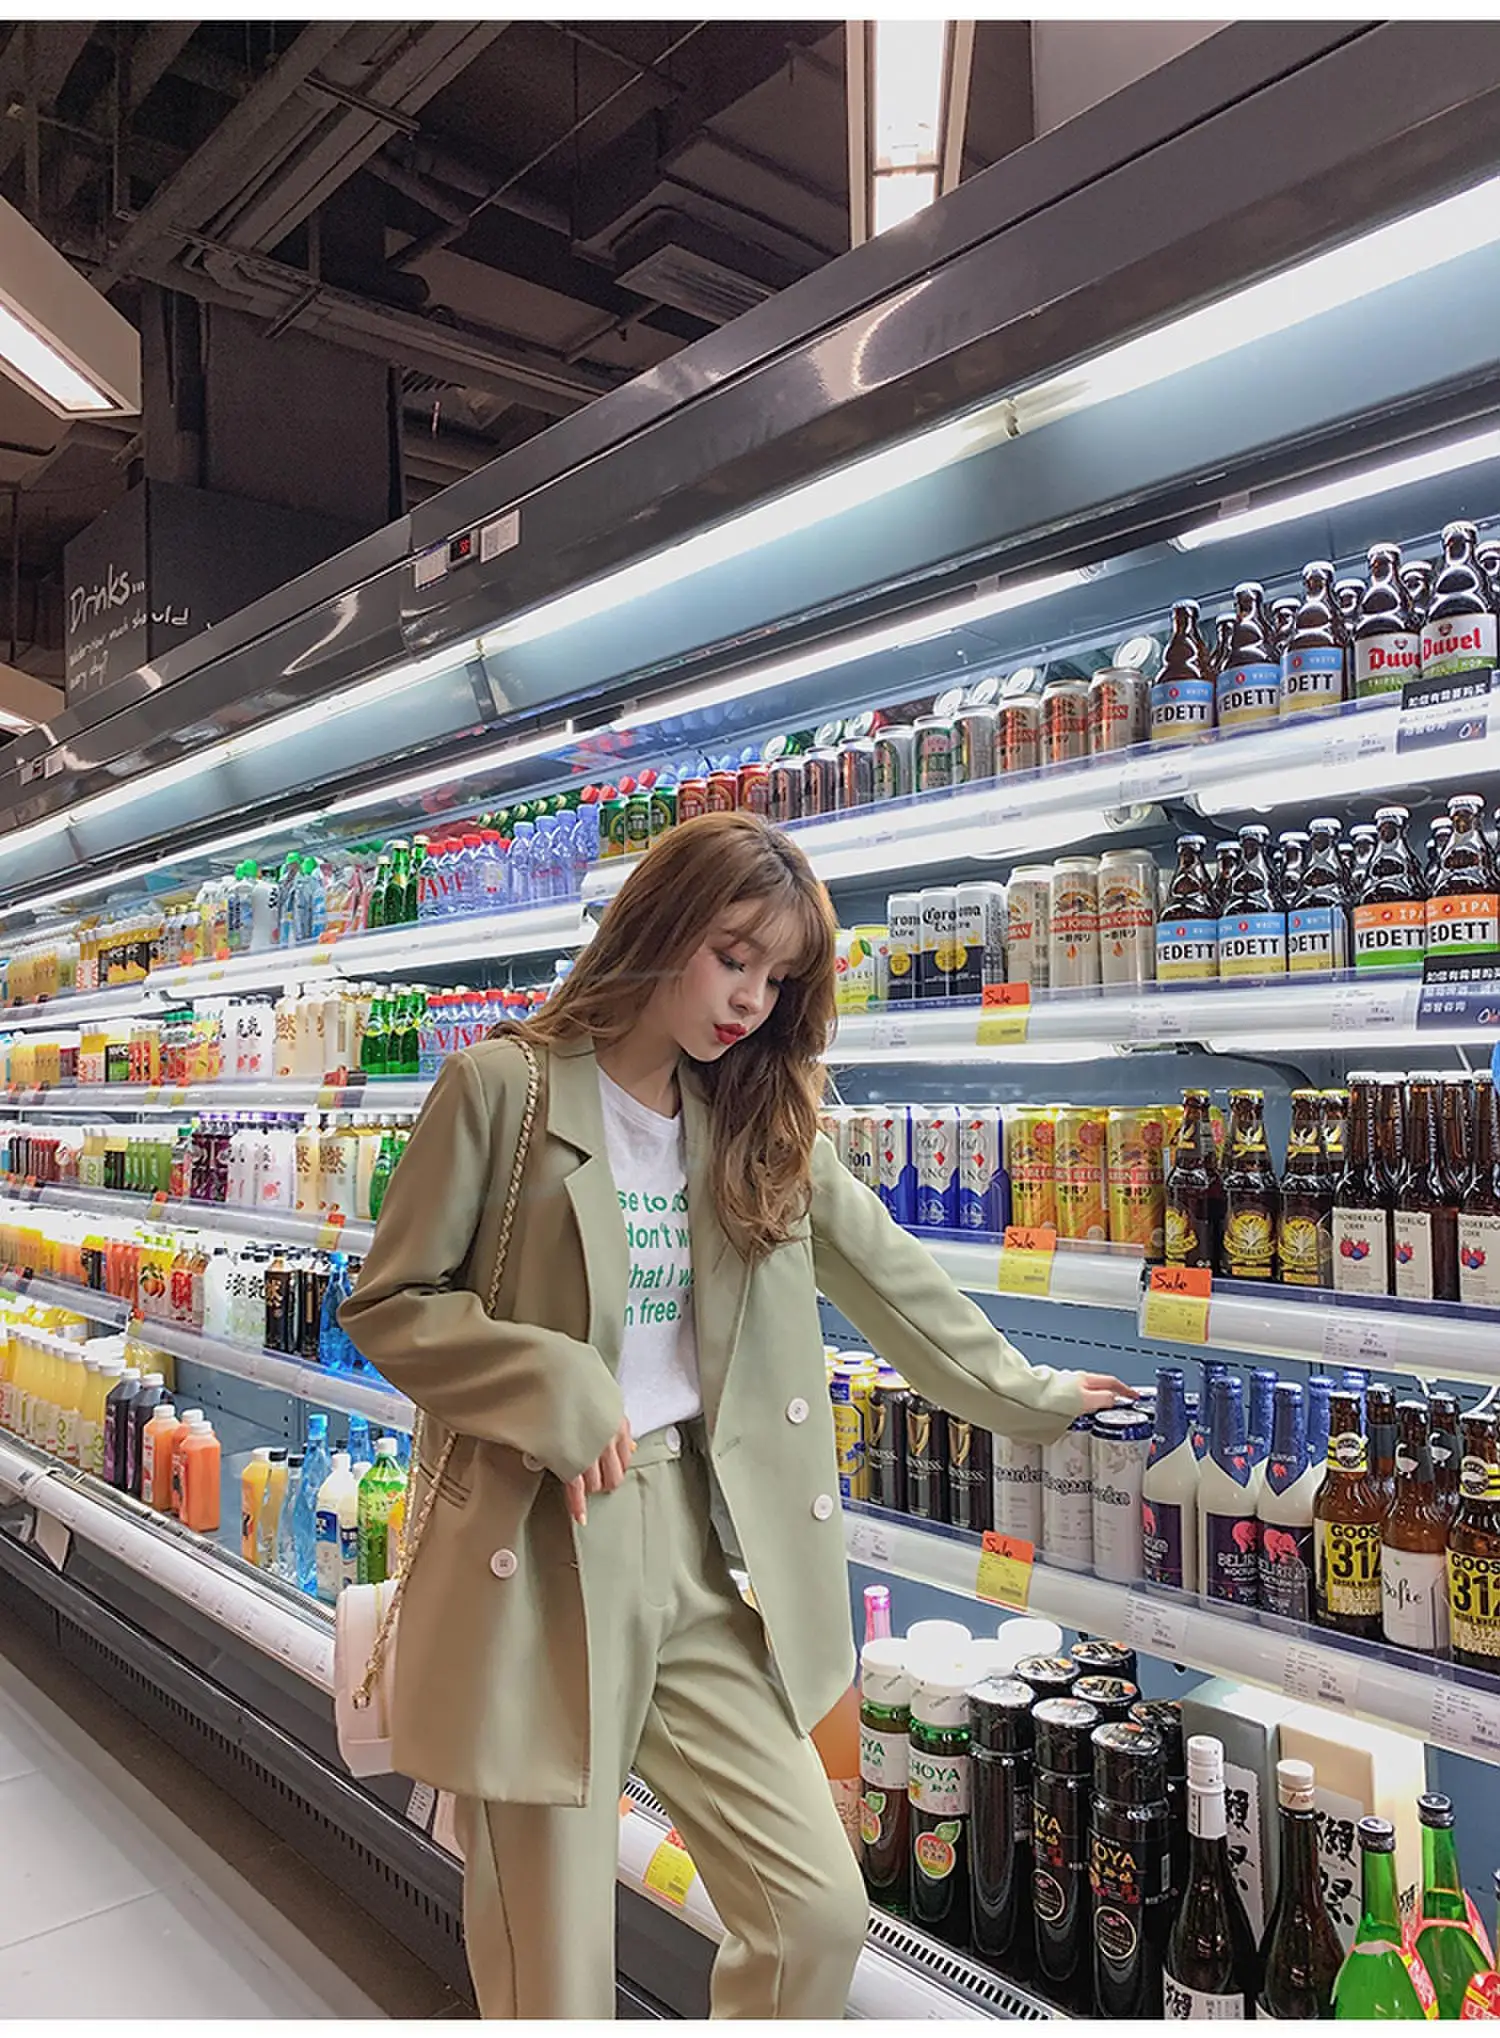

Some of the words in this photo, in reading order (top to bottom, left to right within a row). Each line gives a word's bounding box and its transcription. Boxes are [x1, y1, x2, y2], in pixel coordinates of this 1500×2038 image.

[1460, 902, 1490, 913] IPA
[643, 1192, 668, 1213] to
[1008, 1231, 1036, 1249] Sale
[1154, 1273, 1188, 1290] Sale
[640, 1296, 682, 1325] free.
[1331, 1524, 1381, 1538] GOOS
[1451, 1553, 1500, 1575] GOOS
